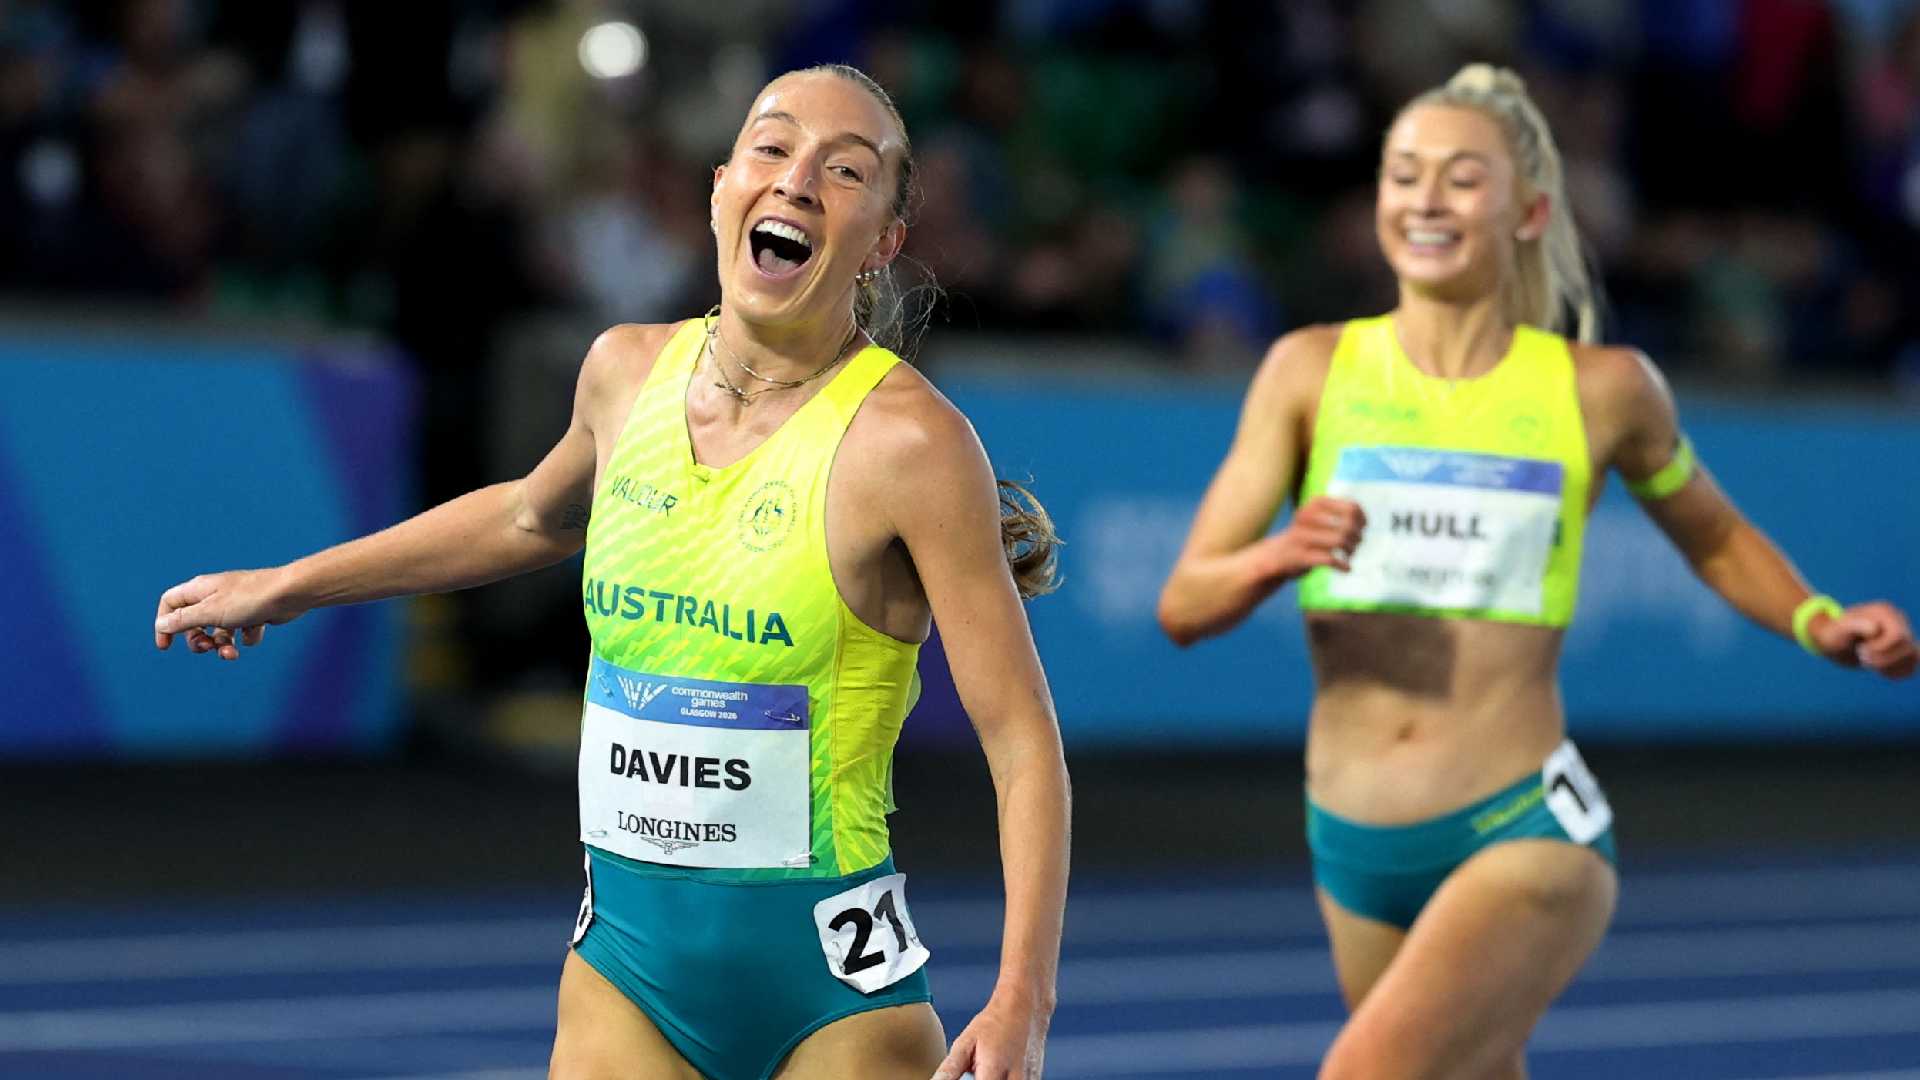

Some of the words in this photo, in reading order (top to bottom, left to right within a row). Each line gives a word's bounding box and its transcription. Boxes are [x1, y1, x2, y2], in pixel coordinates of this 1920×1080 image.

[1391, 512, 1487, 540] HULL
[585, 578, 795, 647] AUSTRALIA
[672, 685, 749, 701] commonwealth
[691, 698, 726, 708] games
[680, 707, 717, 718] GLASGOW
[610, 742, 752, 791] DAVIES
[617, 811, 737, 842] LONGINES
[828, 889, 909, 976] 21
